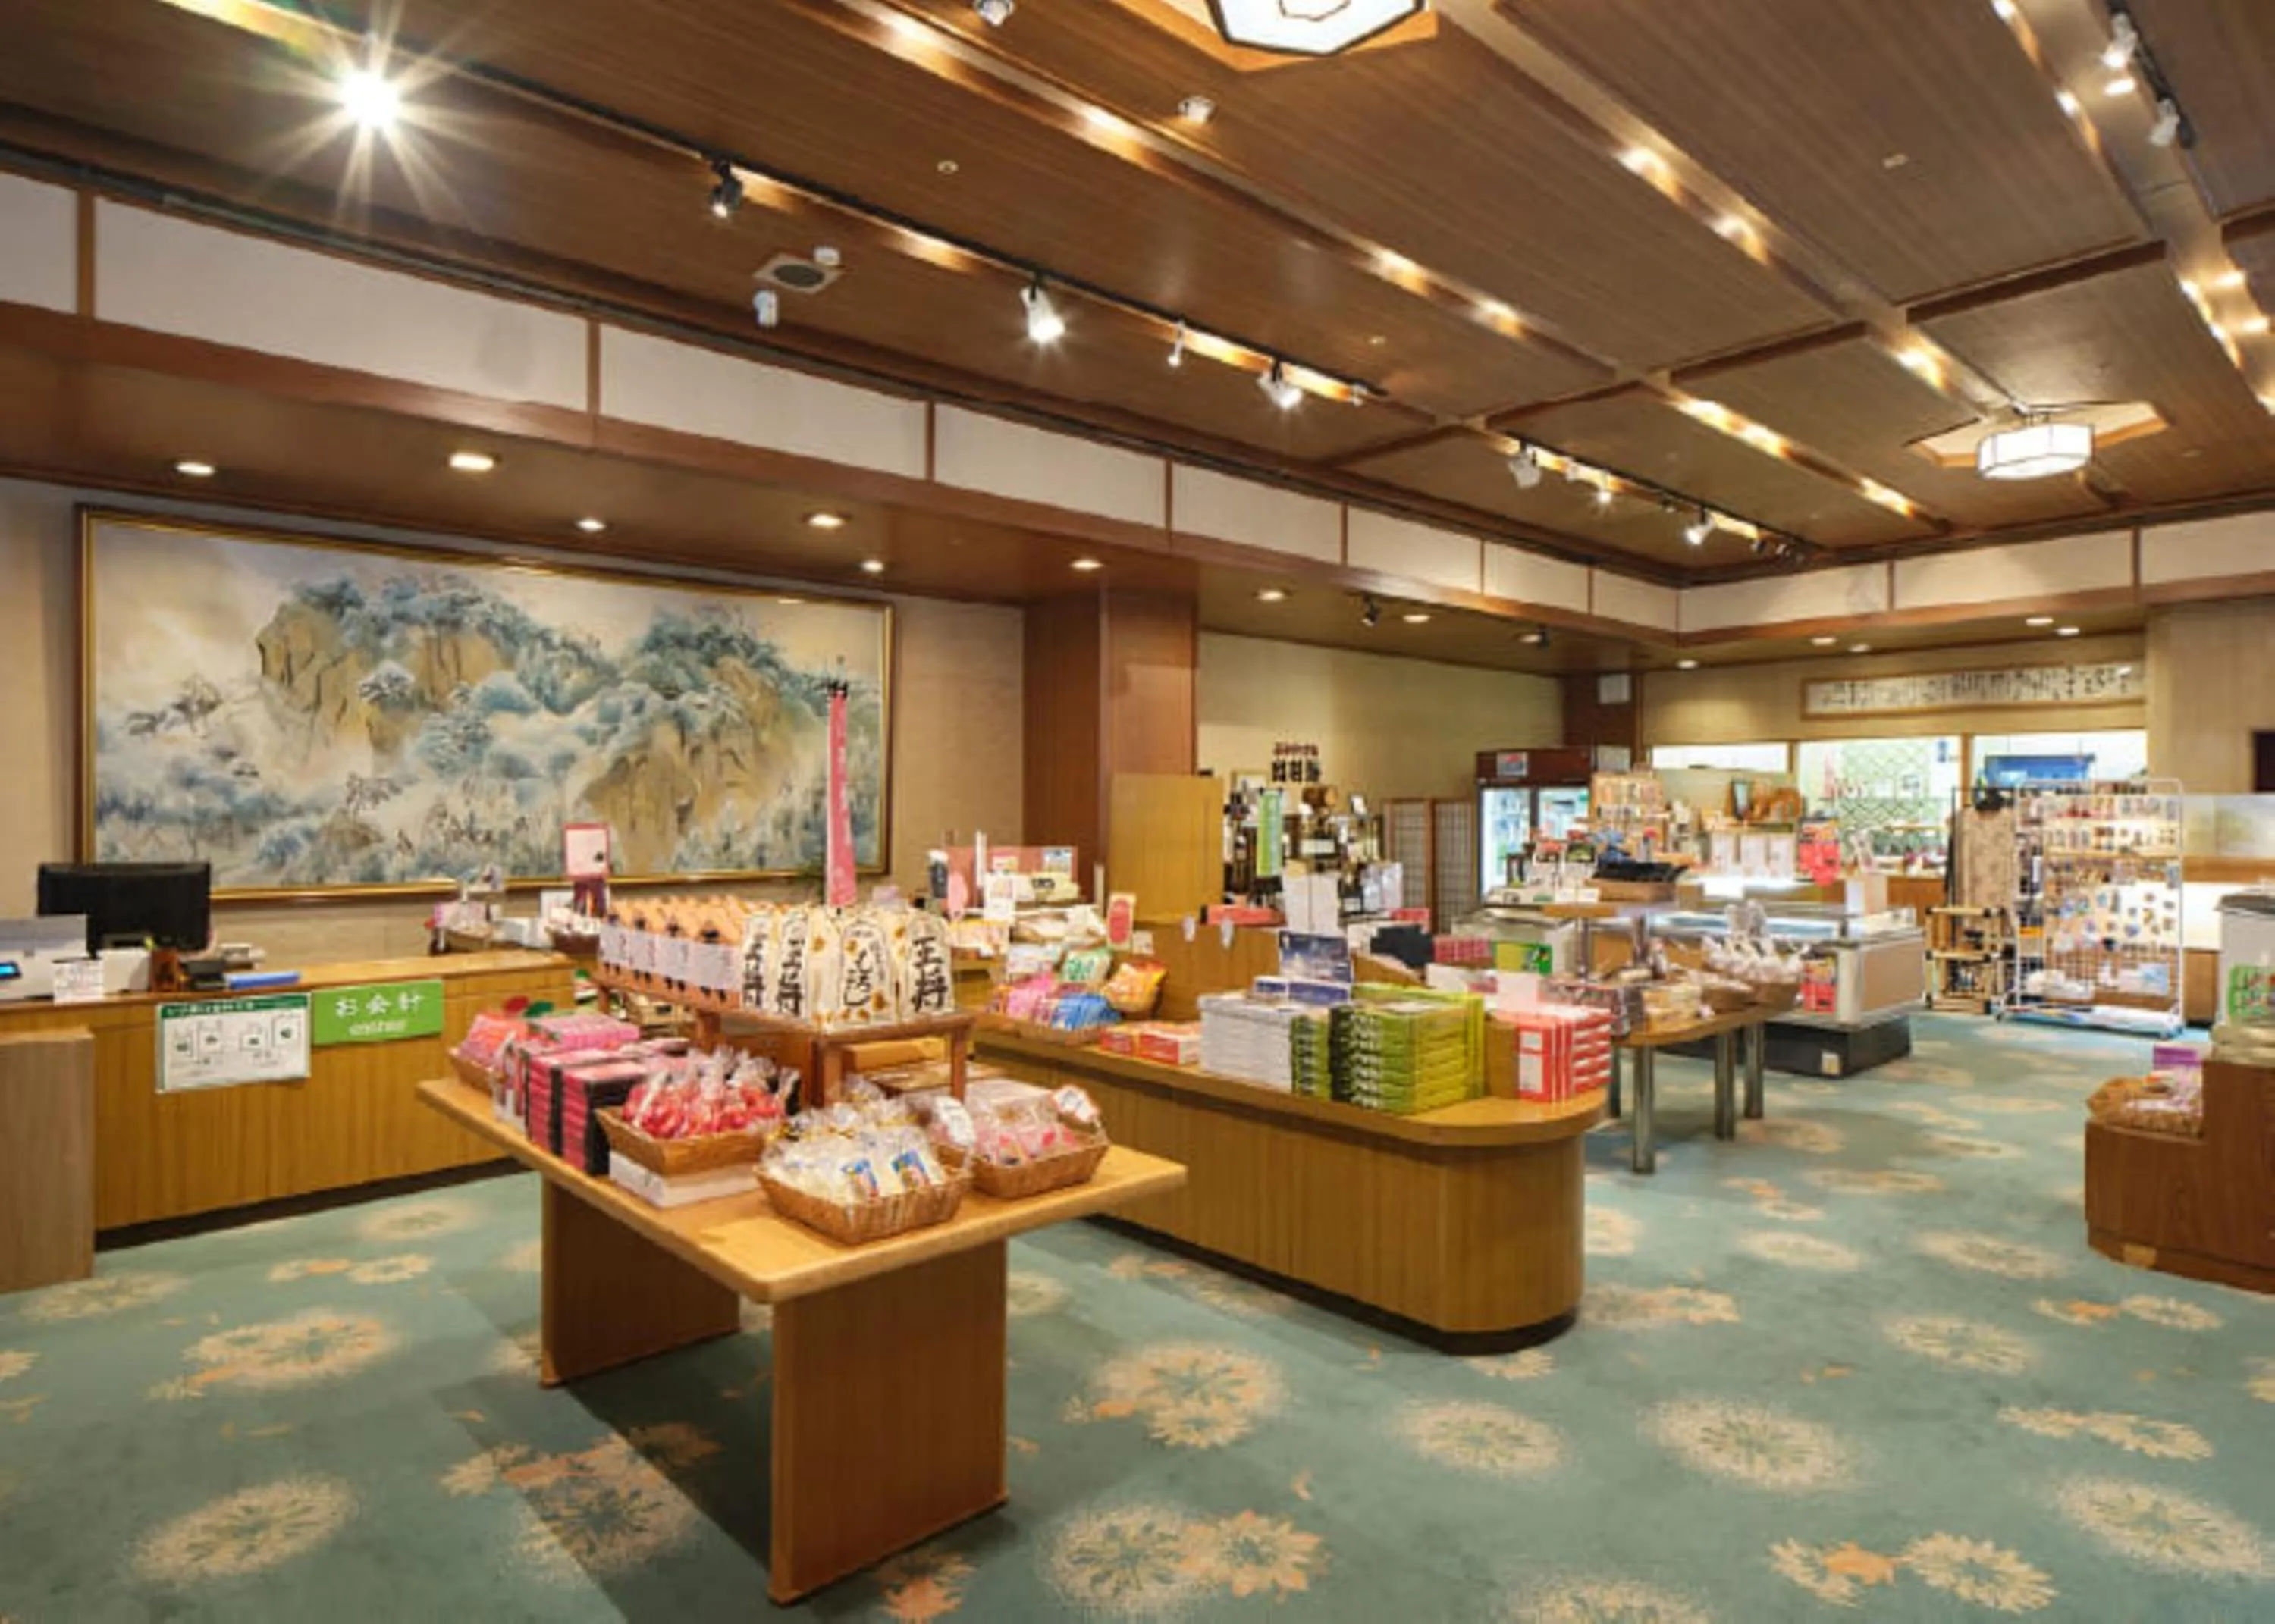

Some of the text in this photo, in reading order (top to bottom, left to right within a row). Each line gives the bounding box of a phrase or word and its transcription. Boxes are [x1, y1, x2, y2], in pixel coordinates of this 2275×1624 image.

[912, 937, 948, 1011] 王将
[336, 992, 423, 1018] お会計
